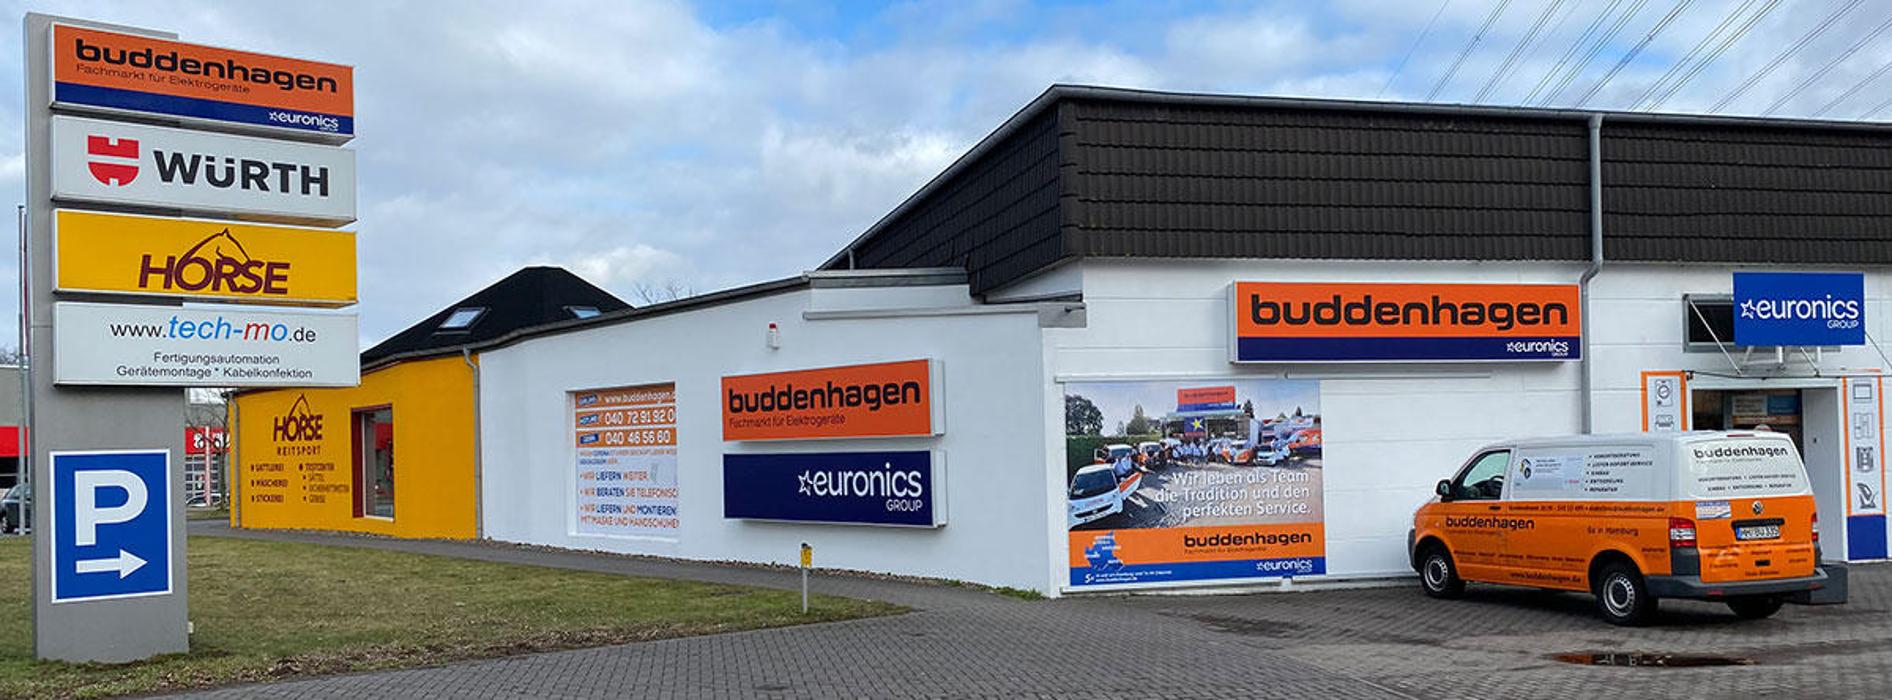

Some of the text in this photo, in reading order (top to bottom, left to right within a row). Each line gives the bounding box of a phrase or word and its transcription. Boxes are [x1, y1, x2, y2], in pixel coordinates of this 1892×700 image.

[75, 38, 337, 93] buddenhagen
[76, 63, 250, 94] Fachmarkt für Elektrogeräte
[278, 111, 339, 128] euronics
[153, 150, 329, 197] WÜRTH
[138, 254, 290, 295] HORSE
[1251, 294, 1568, 331] buddenhagen
[1756, 294, 1859, 319] euronics
[110, 315, 317, 343] www.tech-mo.de
[1827, 319, 1859, 329] GROUP
[1515, 339, 1569, 352] euronics
[153, 352, 280, 366] Fertigungsautomation
[116, 365, 313, 379] Gerätemontage Kabelkonfektion
[728, 381, 921, 413] buddenhagen
[605, 411, 624, 425] 040
[627, 411, 639, 424] 72
[786, 413, 846, 428] Elektrogeräte
[273, 414, 323, 442] HORSE
[605, 431, 625, 445] 040
[277, 445, 321, 457] REITSPORT
[1693, 446, 1788, 458] buddenhagen
[813, 462, 922, 497] euronics
[1173, 469, 1310, 485] Wir leben als Team
[1156, 485, 1310, 502] die Tradition und den
[75, 470, 149, 546] P
[886, 499, 923, 511] GROUP
[1183, 500, 1312, 520] perfekten Service.
[1446, 517, 1534, 530] buddenhagen
[1184, 532, 1312, 548] buddenhagen
[1263, 559, 1312, 573] euronics
